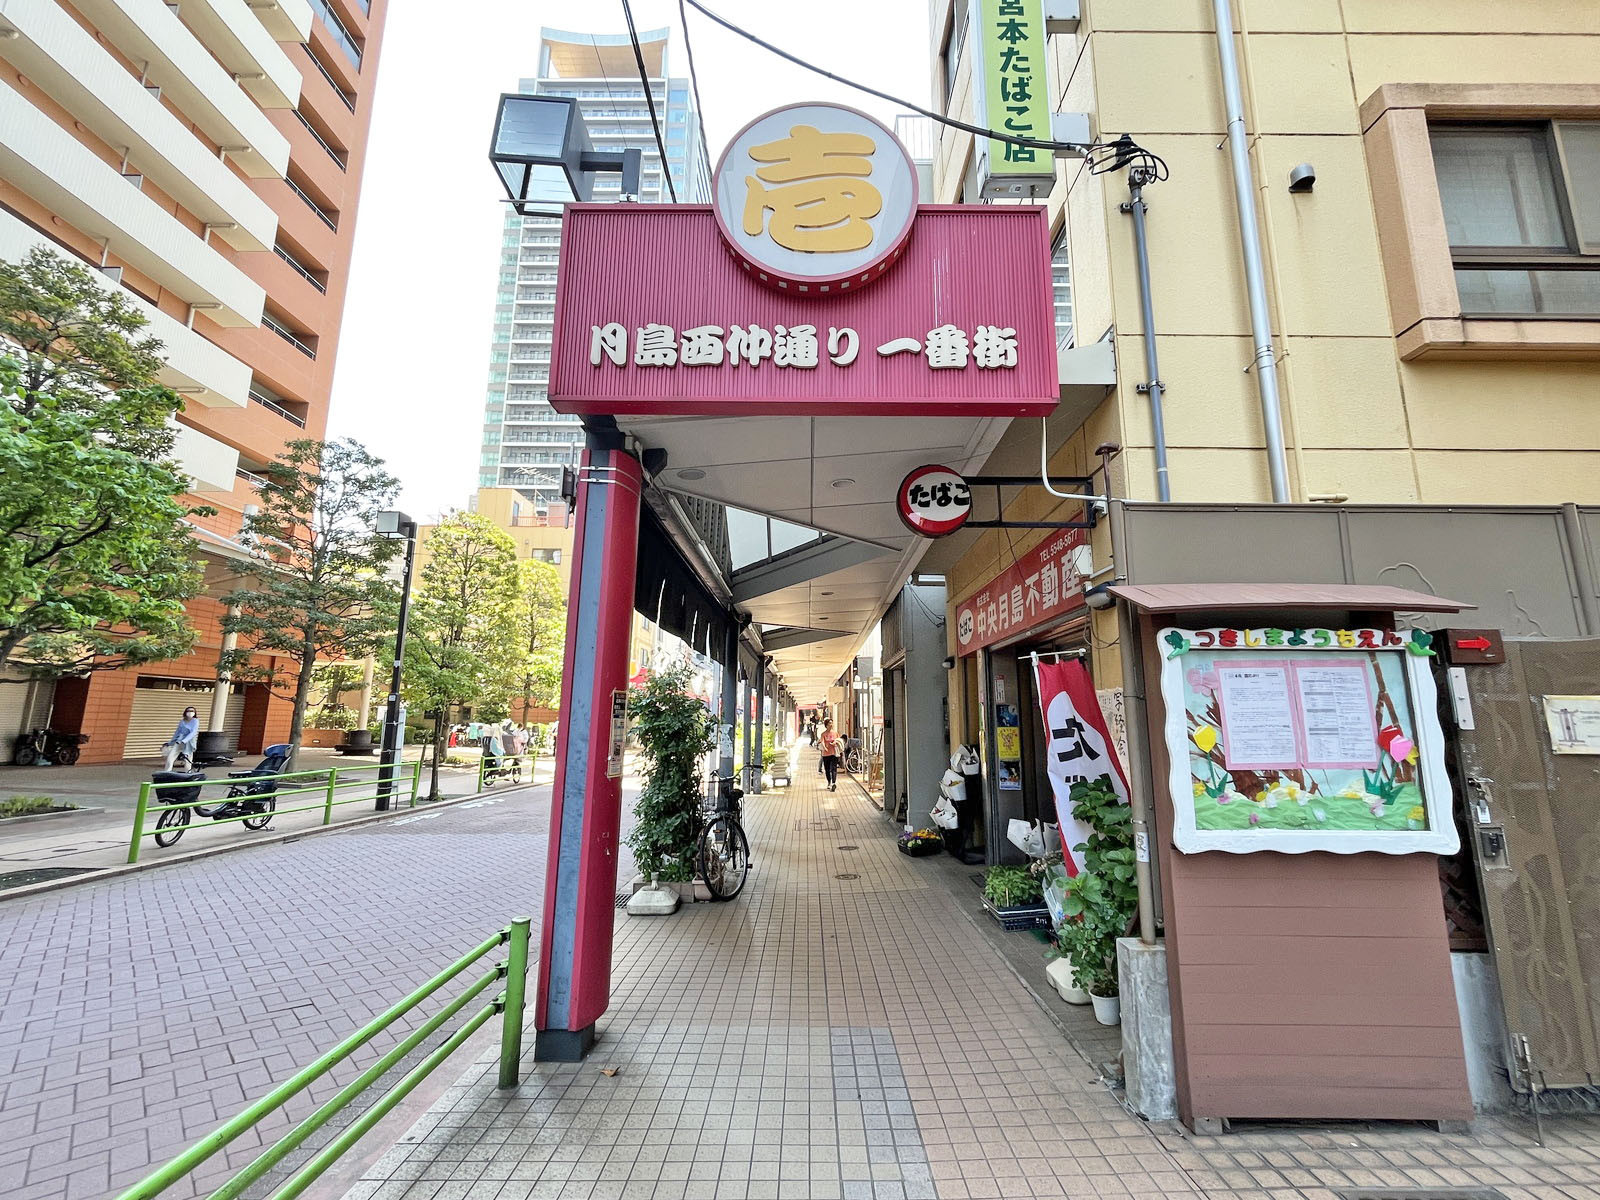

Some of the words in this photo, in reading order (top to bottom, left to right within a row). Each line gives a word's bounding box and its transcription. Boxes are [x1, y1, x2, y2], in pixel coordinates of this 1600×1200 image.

[996, 0, 1036, 162] 宮本たばこ店
[909, 482, 970, 508] たばこ
[1040, 549, 1050, 562] TEL
[977, 549, 1081, 640] 中央月島不動産
[1195, 627, 1402, 648] つきしまようちえん
